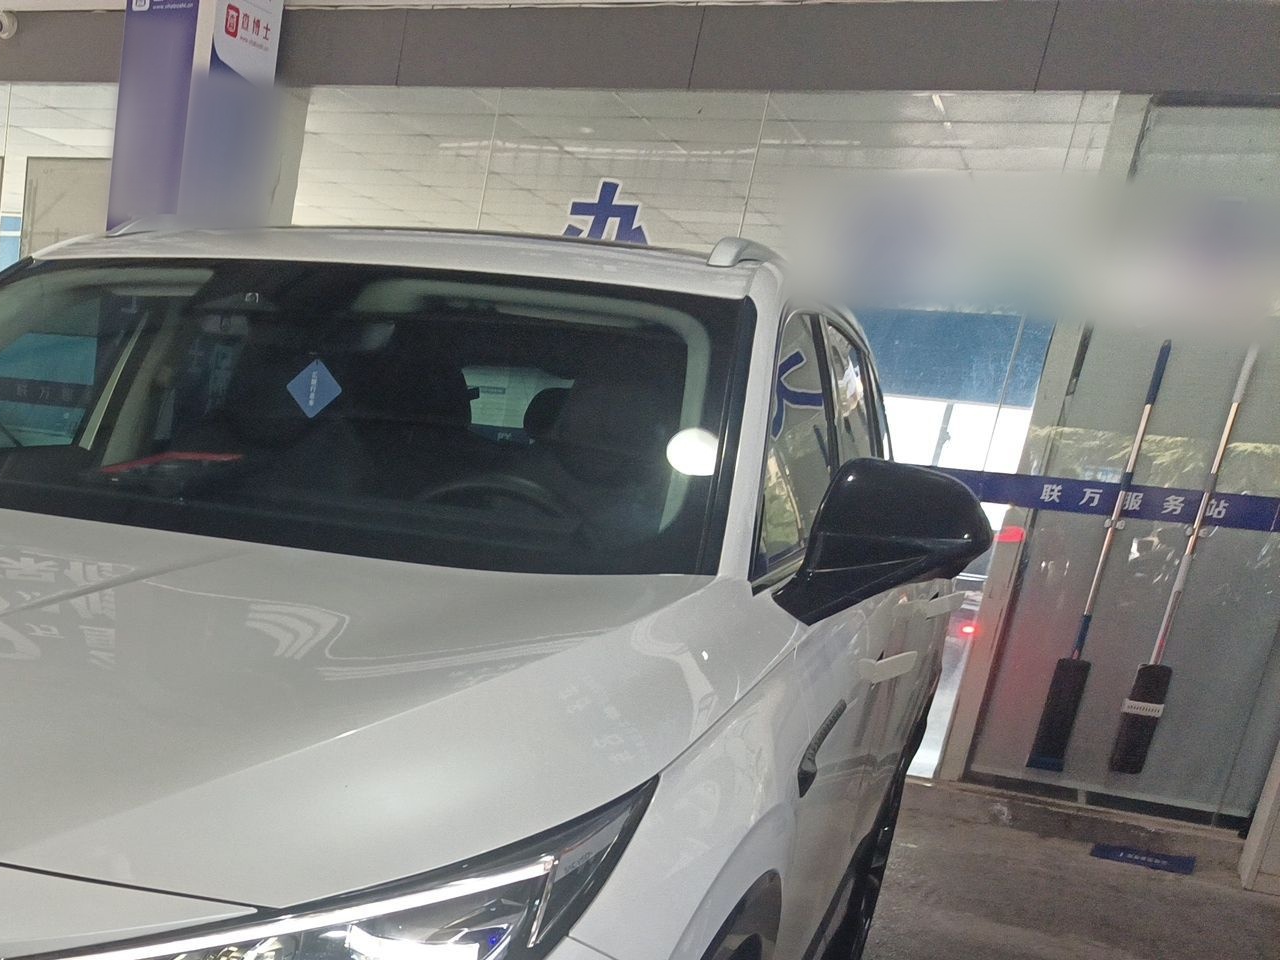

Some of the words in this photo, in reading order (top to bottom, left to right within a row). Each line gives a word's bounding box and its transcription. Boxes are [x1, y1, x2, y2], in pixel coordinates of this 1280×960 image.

[1039, 483, 1230, 519] 联万服务站
